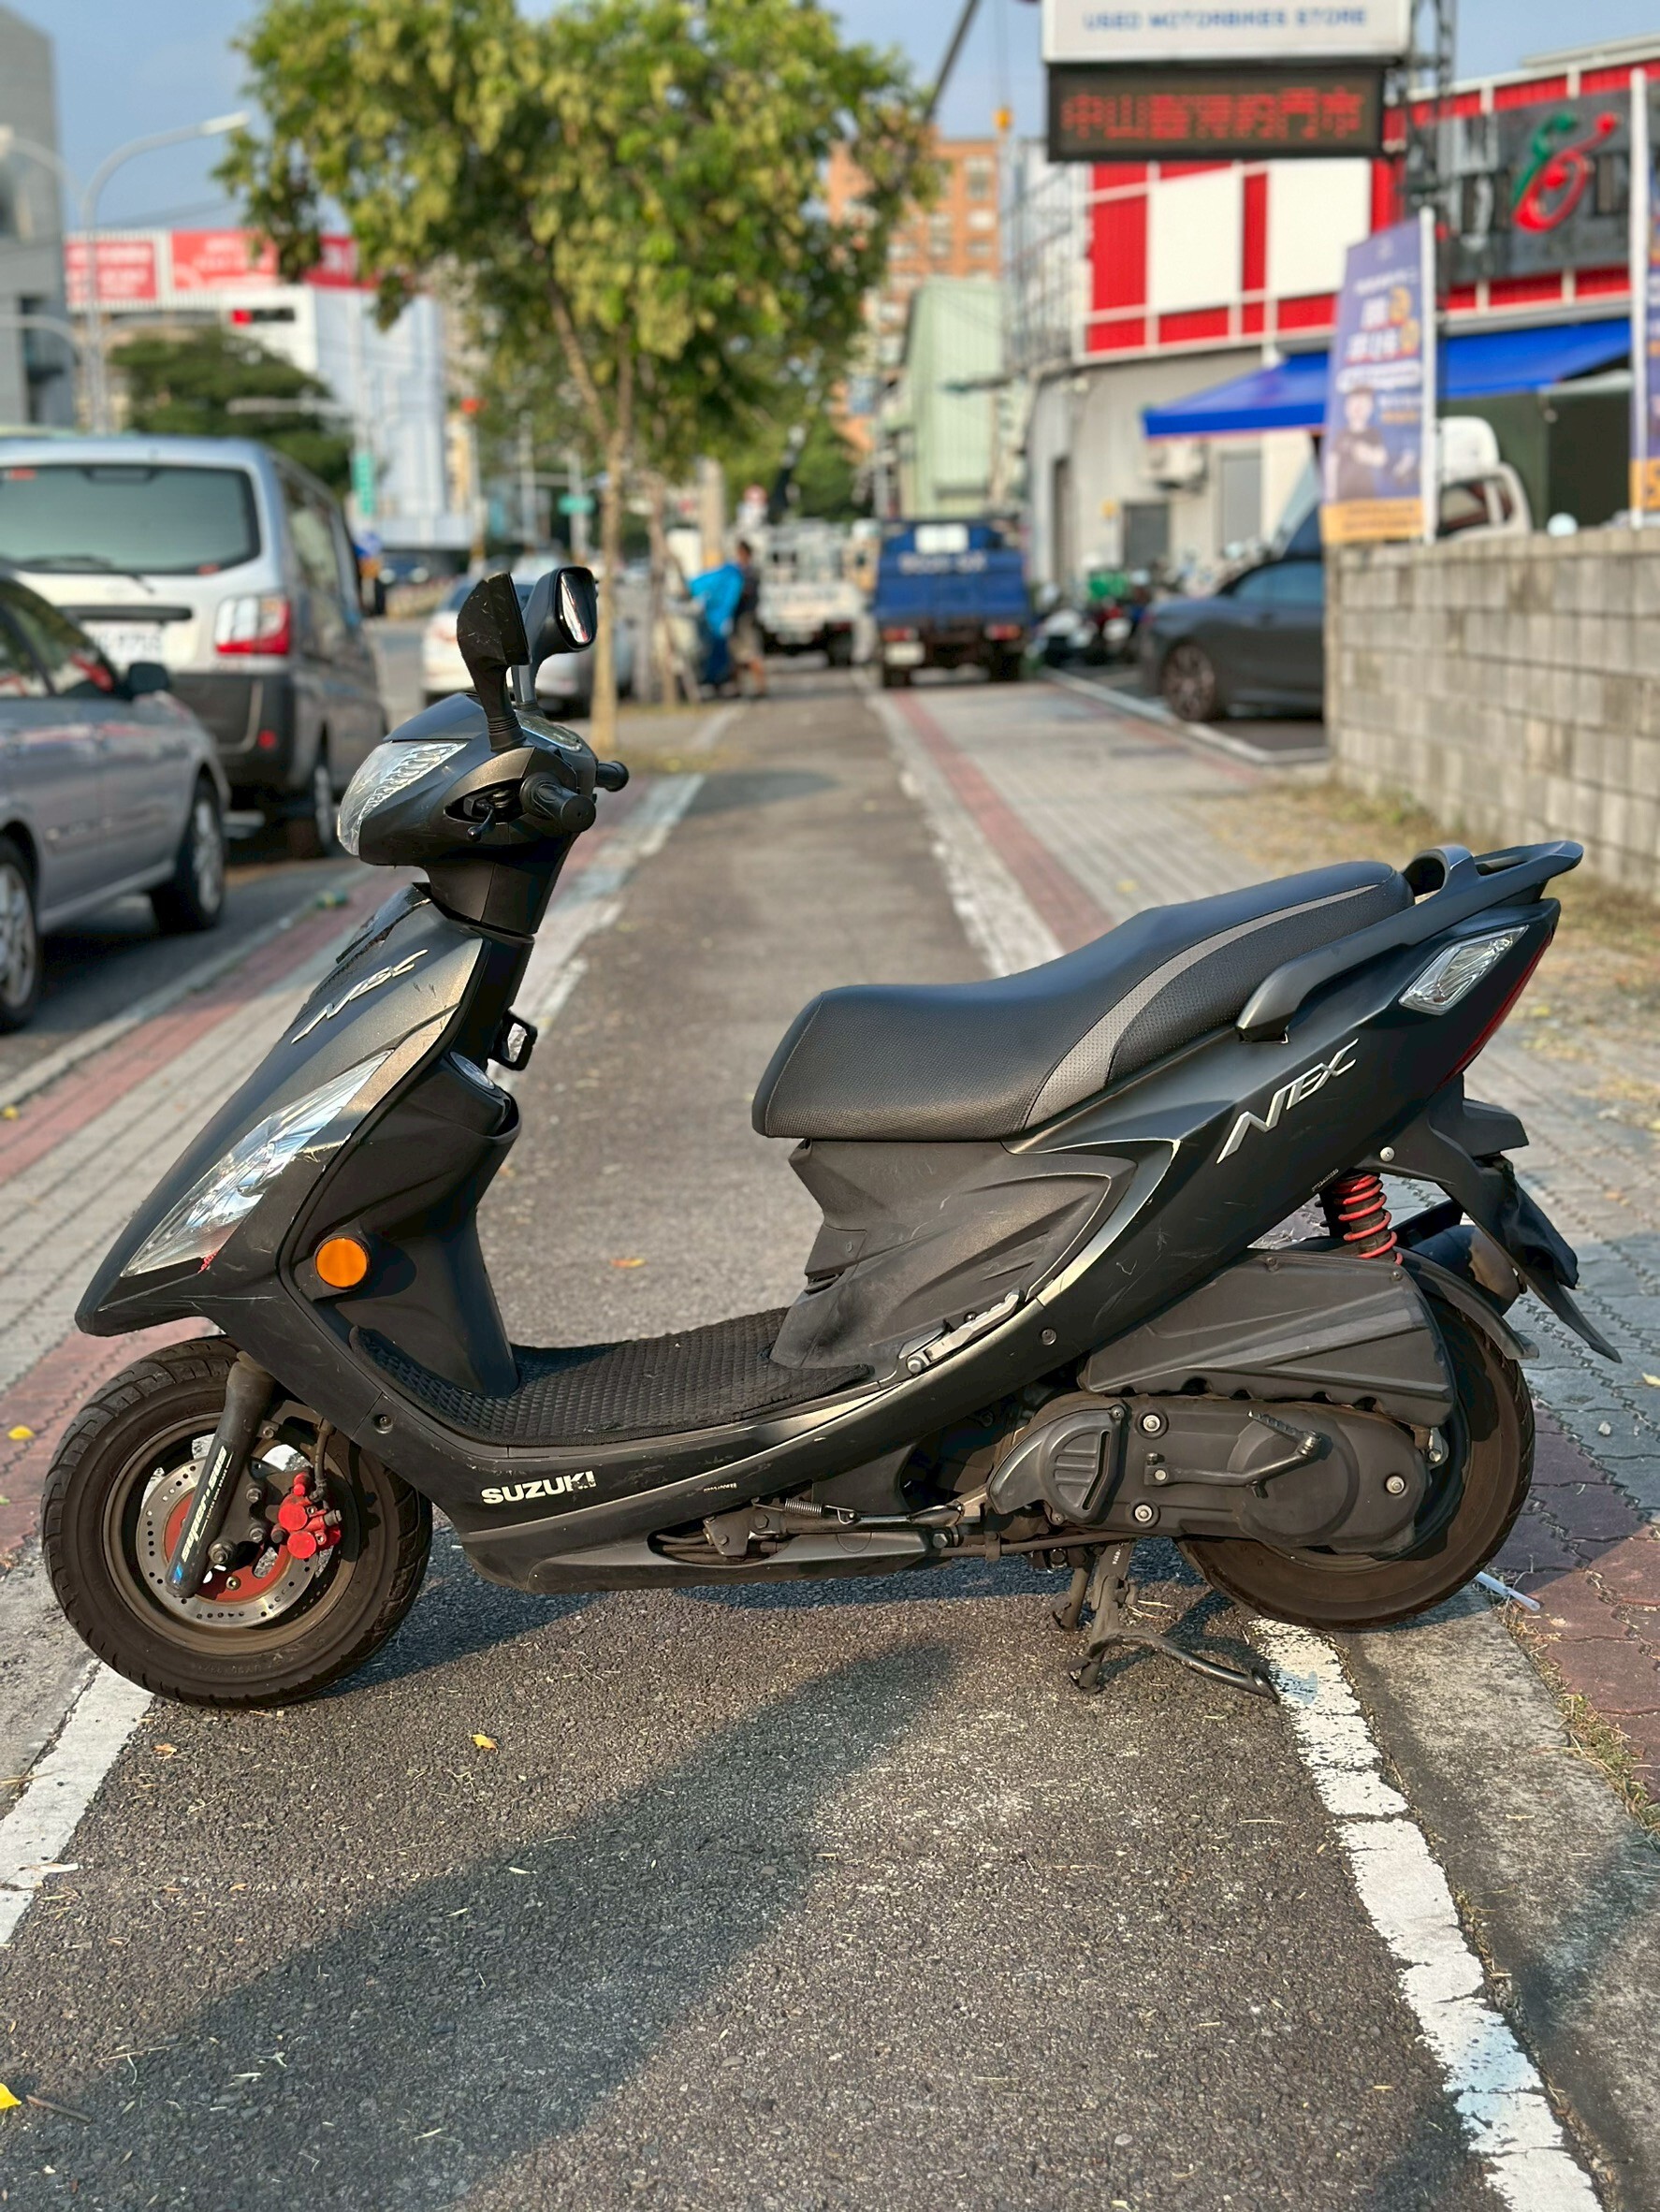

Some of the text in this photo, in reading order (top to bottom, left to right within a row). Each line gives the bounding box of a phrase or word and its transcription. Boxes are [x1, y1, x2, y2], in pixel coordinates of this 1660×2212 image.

[1083, 7, 1366, 31] USED MOTORBIKES STORE
[1216, 1038, 1360, 1164] NEX
[481, 1470, 597, 1505] SUZUKI
